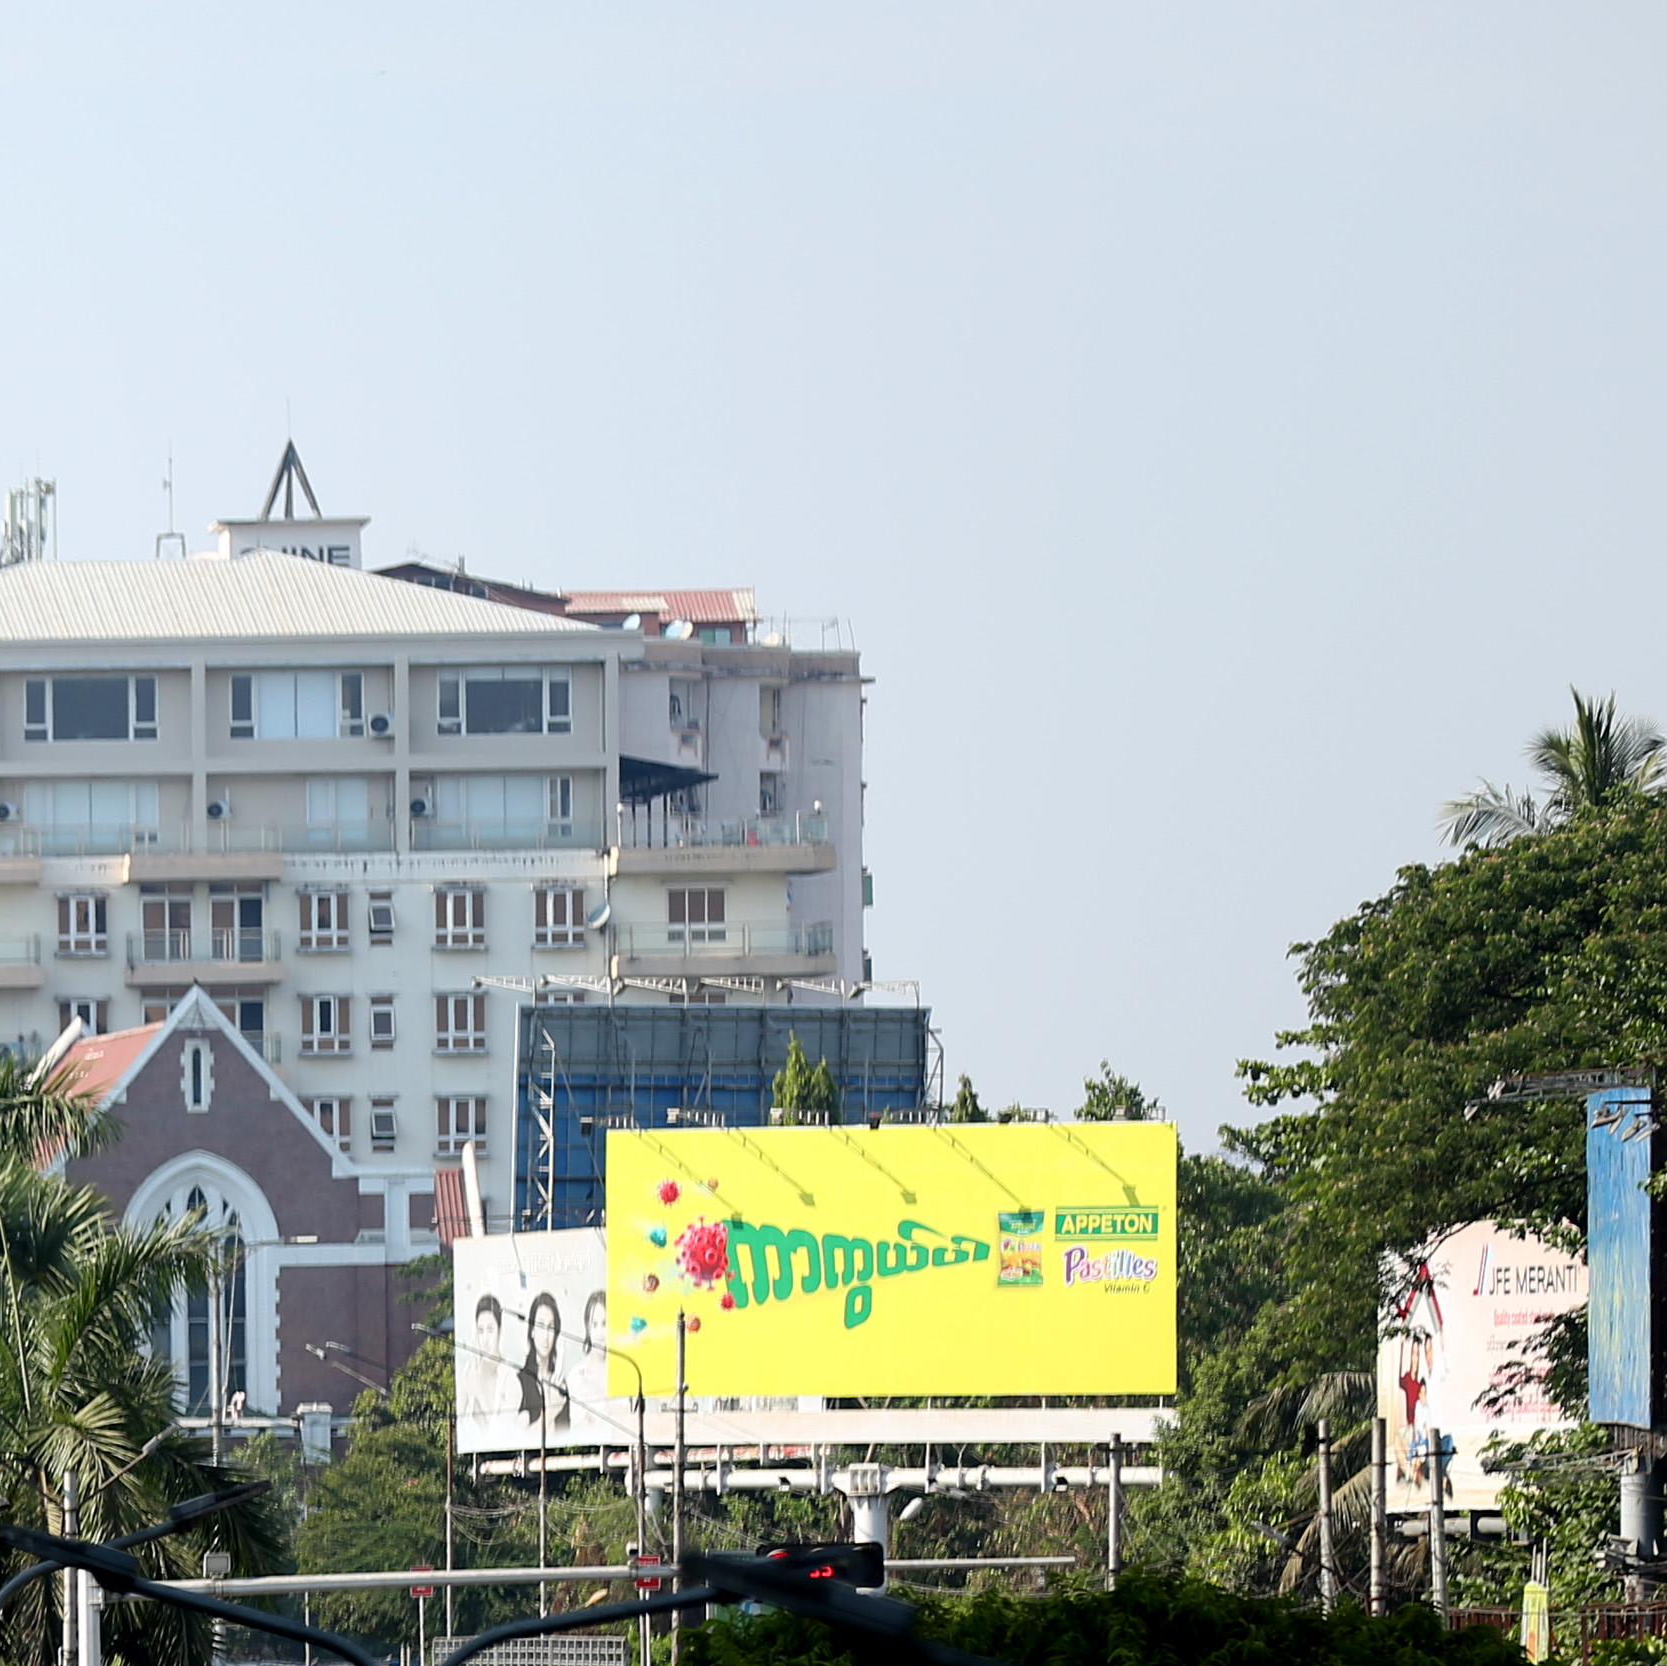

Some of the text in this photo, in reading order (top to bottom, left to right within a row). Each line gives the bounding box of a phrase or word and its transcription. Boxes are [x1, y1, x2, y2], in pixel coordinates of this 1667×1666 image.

[1061, 1214, 1152, 1234] APPETON
[1064, 1245, 1156, 1284] Pastilles
[1104, 1283, 1140, 1294] Vitamin
[1489, 1264, 1577, 1295] JFE MERANTI
